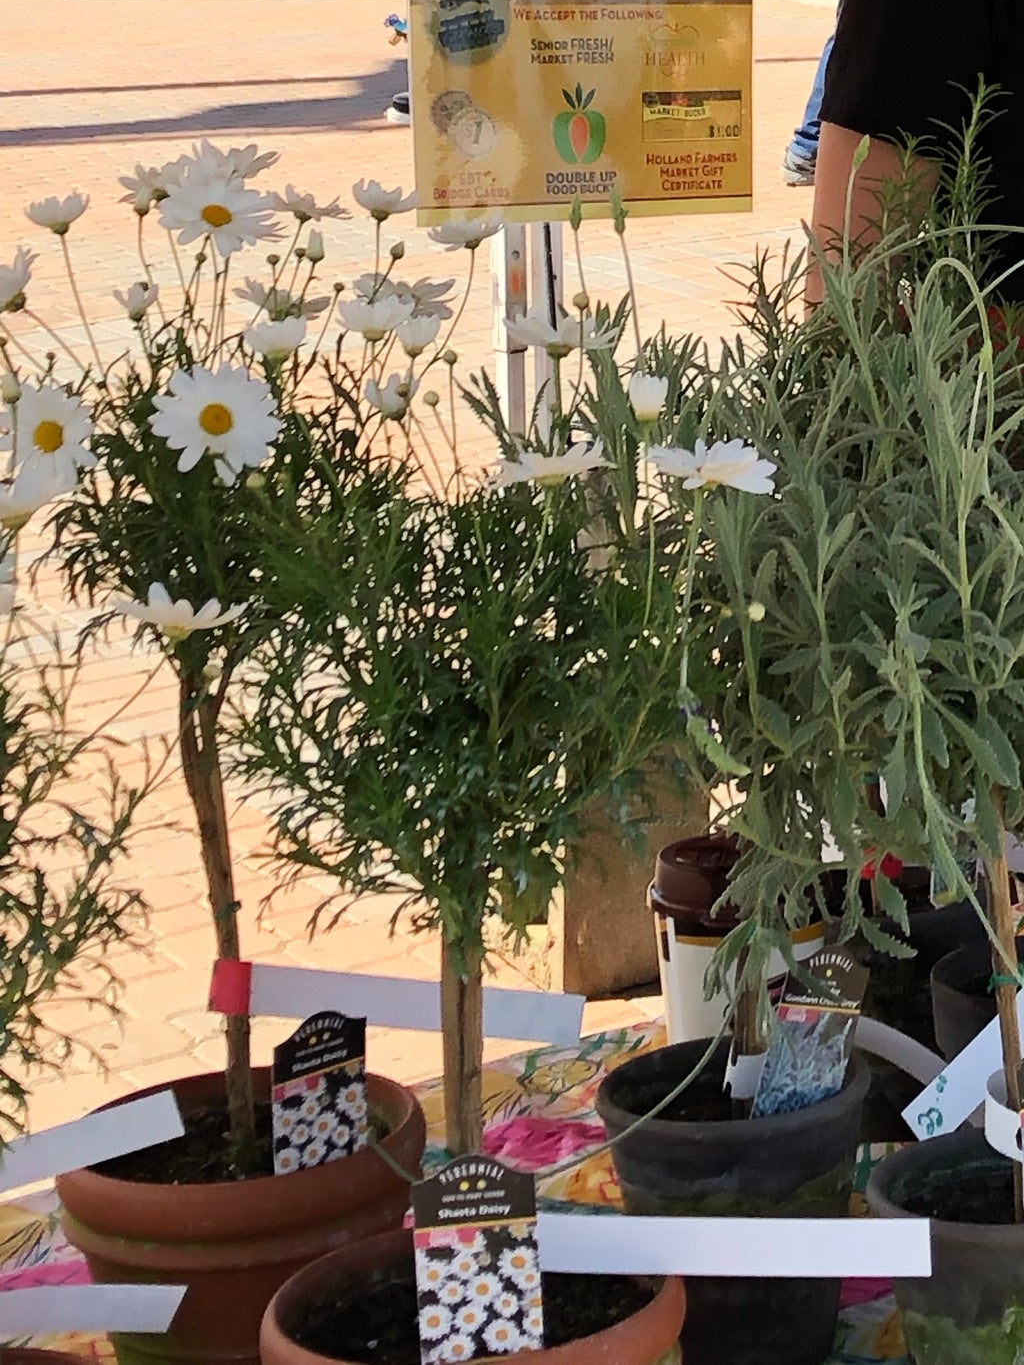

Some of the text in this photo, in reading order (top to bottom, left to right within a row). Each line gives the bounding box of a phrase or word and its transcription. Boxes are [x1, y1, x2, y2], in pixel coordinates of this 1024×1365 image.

[534, 9, 576, 20] ACCEPT
[579, 9, 598, 20] THE
[530, 51, 614, 64] MARKET FRESH
[646, 152, 737, 166] HOLLAND FARMERS
[546, 170, 617, 184] DOUBLE UP
[660, 165, 724, 178] MARKET GIFT
[546, 184, 578, 195] FOOD
[662, 179, 723, 191] CERTIFICATE
